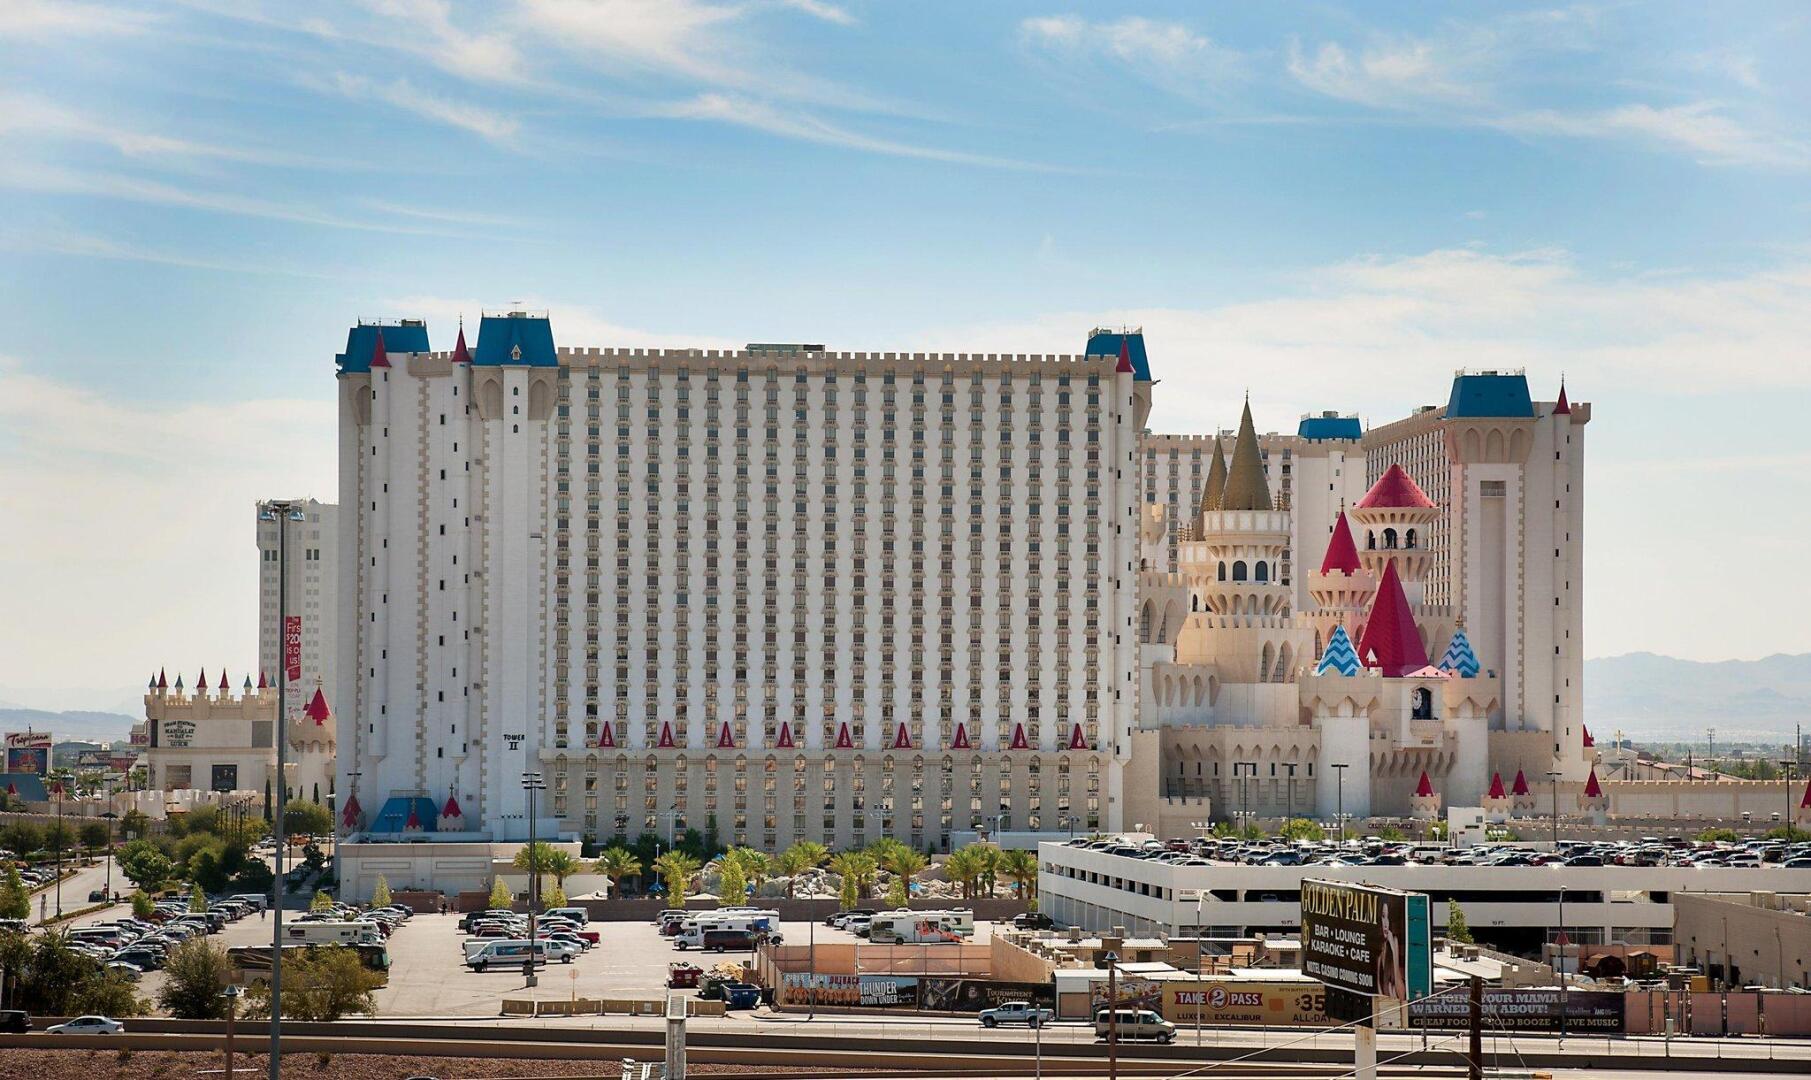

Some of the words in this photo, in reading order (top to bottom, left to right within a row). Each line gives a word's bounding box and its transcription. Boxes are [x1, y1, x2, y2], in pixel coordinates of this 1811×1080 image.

[287, 622, 301, 633] Firs
[1301, 883, 1344, 918] GOLDEN
[1345, 890, 1378, 924] PALM
[1314, 924, 1329, 938] BAR
[1335, 928, 1366, 946] LOUNGE
[1311, 938, 1345, 957] KARAOKE
[1350, 948, 1370, 963] CAFE
[1321, 962, 1338, 979] CASINO
[1339, 968, 1358, 984] COMING
[1359, 973, 1373, 987] SOON
[860, 981, 897, 994] THUNDER
[986, 987, 1033, 998] TOURNAMENT
[860, 995, 878, 1005] DOWN
[879, 994, 898, 1004] UNDER
[1178, 992, 1206, 1005] TAKE
[1231, 992, 1260, 1005] PASS
[1441, 994, 1470, 1005] JOIN
[1516, 993, 1559, 1003] MAMA
[1411, 1004, 1470, 1014] WARNED
[1500, 1004, 1548, 1014] ABOUT!
[1176, 1013, 1206, 1021] LUXOR
[1214, 1013, 1261, 1022] EXCALIBUR
[1413, 1018, 1445, 1026] CHEAP
[1447, 1018, 1471, 1026] FOO
[1517, 1018, 1551, 1026] BOOZE
[1587, 1018, 1619, 1027] MUSIC
